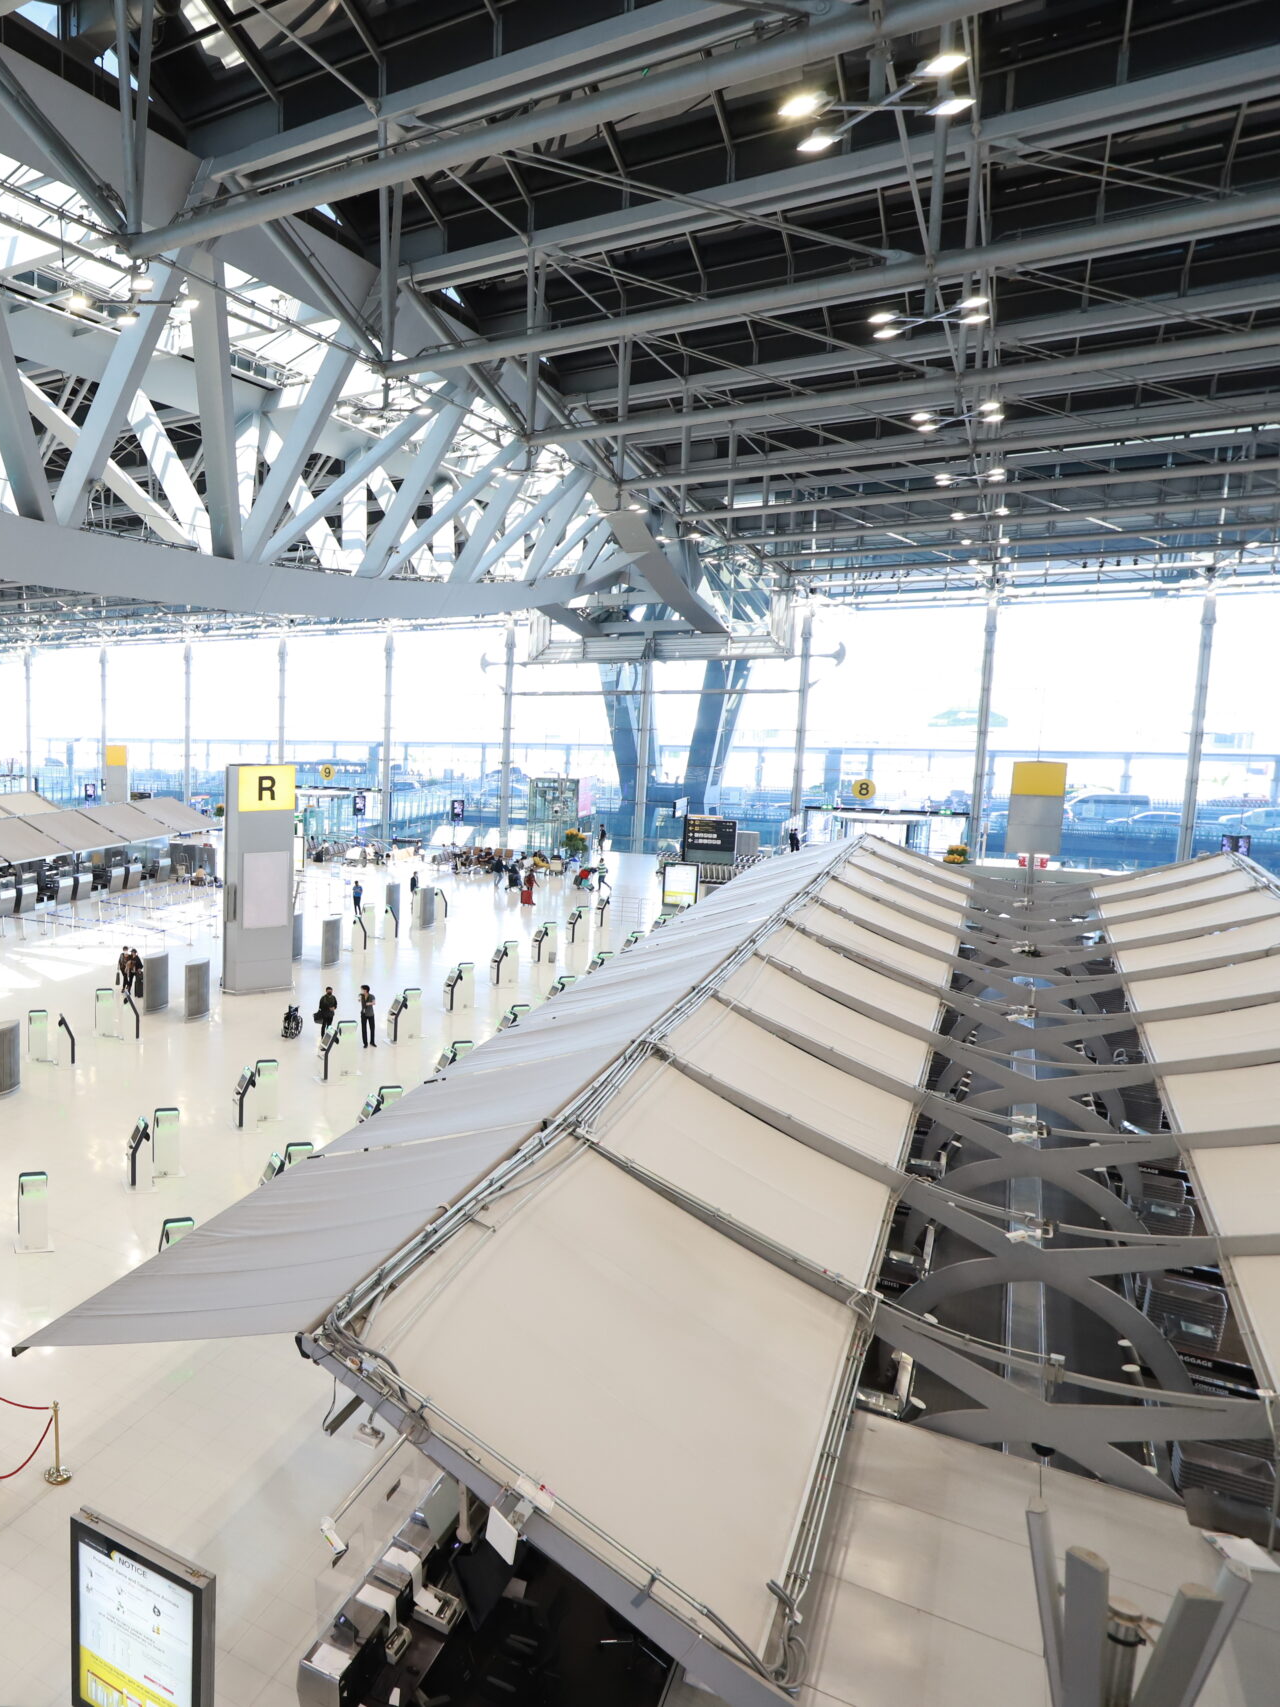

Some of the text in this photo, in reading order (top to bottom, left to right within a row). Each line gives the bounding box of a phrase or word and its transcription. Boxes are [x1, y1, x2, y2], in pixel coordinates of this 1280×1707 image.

[324, 767, 331, 778] 9
[258, 775, 276, 801] R
[859, 782, 869, 796] 8
[1179, 1355, 1213, 1368] AGGAGE
[118, 1557, 148, 1578] NOTICE
